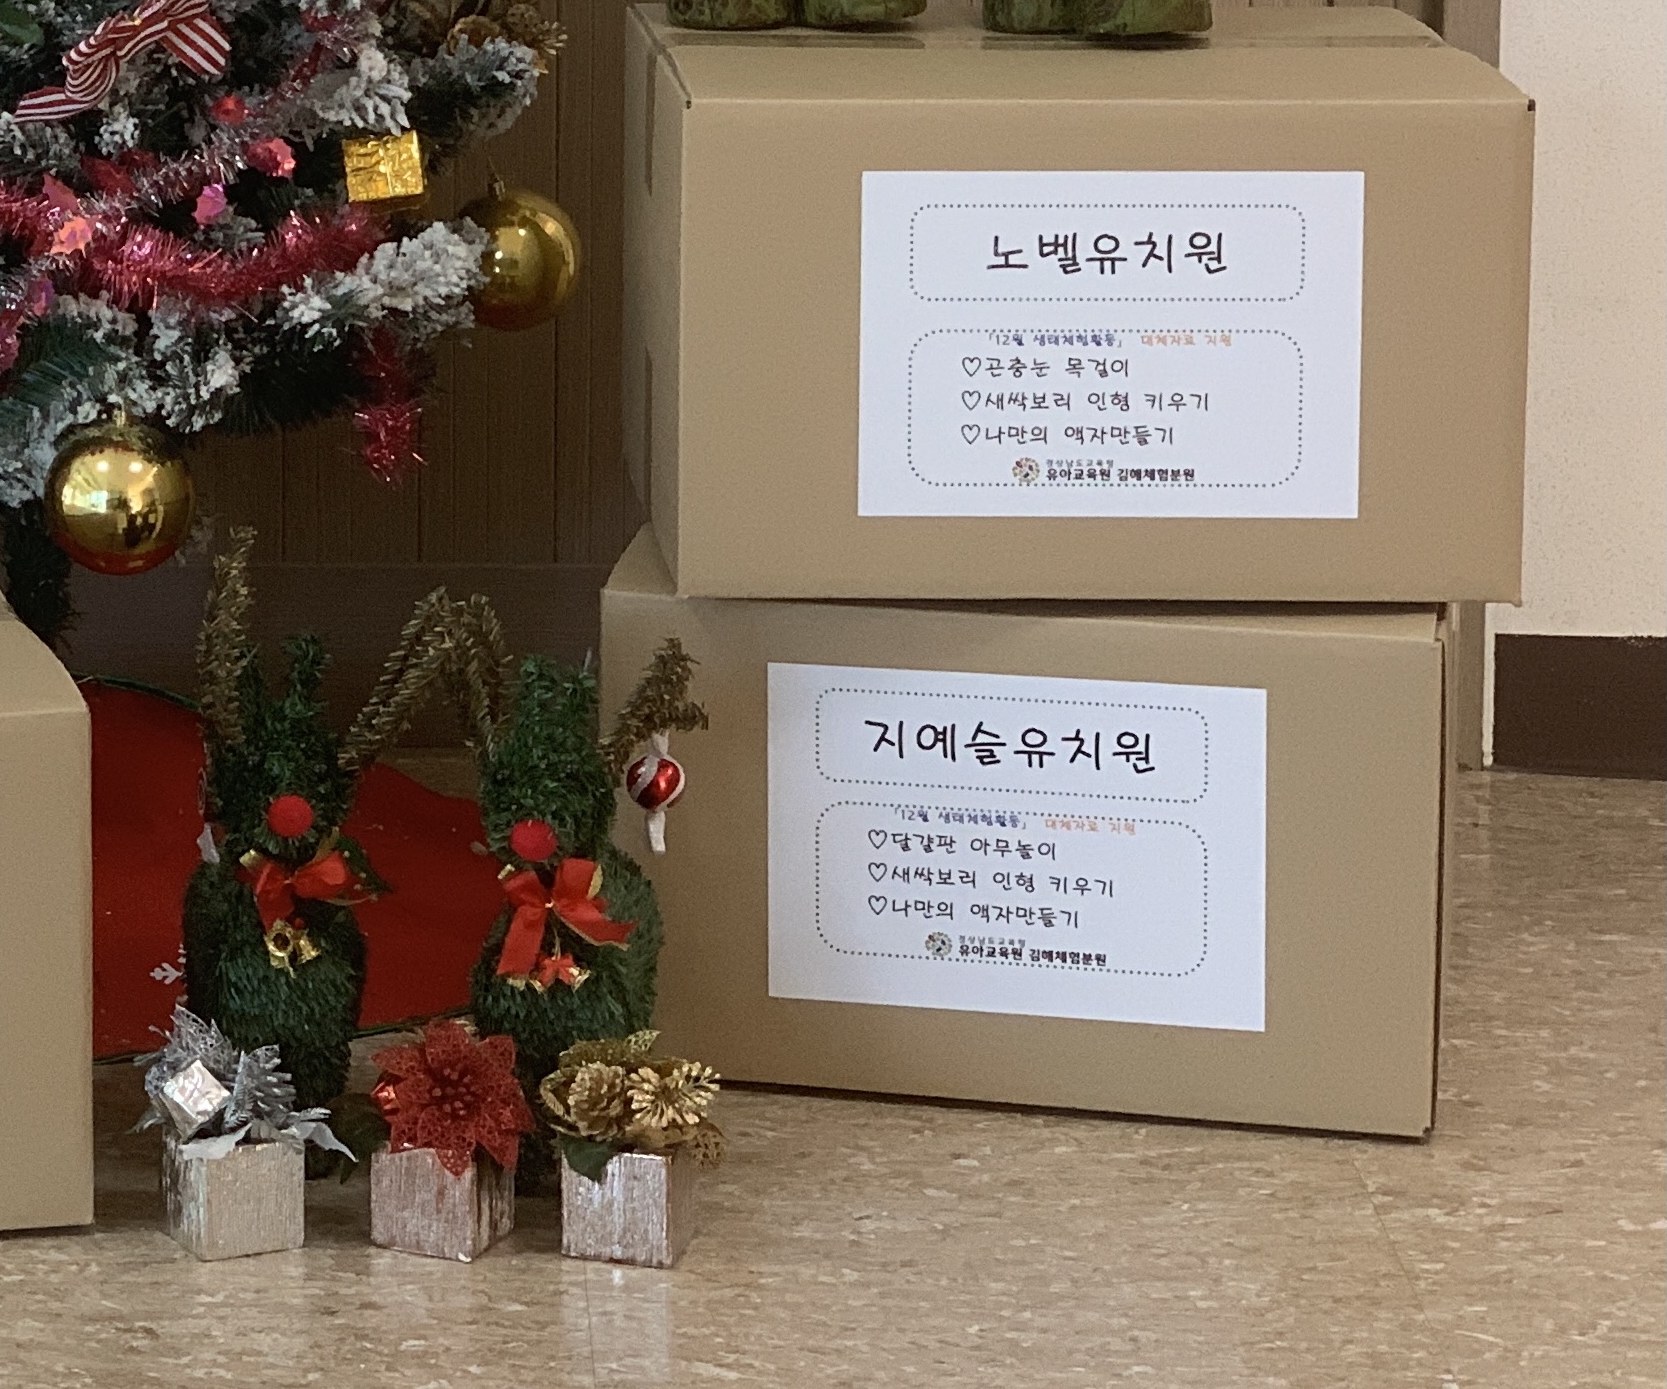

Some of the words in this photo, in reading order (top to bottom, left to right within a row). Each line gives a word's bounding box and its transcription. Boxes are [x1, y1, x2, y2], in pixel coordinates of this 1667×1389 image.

[986, 232, 1228, 275] 노벨유치원
[1141, 334, 1196, 347] 대체자료
[1206, 334, 1232, 347] 지원
[985, 358, 1050, 377] 곤충눈
[1065, 357, 1129, 378] 목걸이
[985, 391, 1071, 412] 새싹보리
[1087, 391, 1131, 411] 인형
[1145, 393, 1209, 411] 키우기
[986, 425, 1048, 445] 나만의
[1064, 424, 1174, 445] 액자만들기
[1046, 468, 1111, 482] 유아교육원
[1117, 468, 1195, 482] 김해체험분원
[865, 719, 1156, 774] 지예슬유치원
[1045, 817, 1099, 833] 대체자료
[1110, 821, 1136, 836] 지원
[891, 833, 957, 855] 달걀판
[970, 838, 1056, 861] 아무놀이
[891, 868, 976, 890] 새싹보리
[993, 873, 1035, 894] 인형
[1049, 876, 1113, 898] 키우기
[892, 901, 954, 921] 나만의
[970, 903, 1079, 929] 액자만들기
[958, 944, 1023, 961] 유아교육원
[1029, 948, 1107, 967] 김해체험분원
